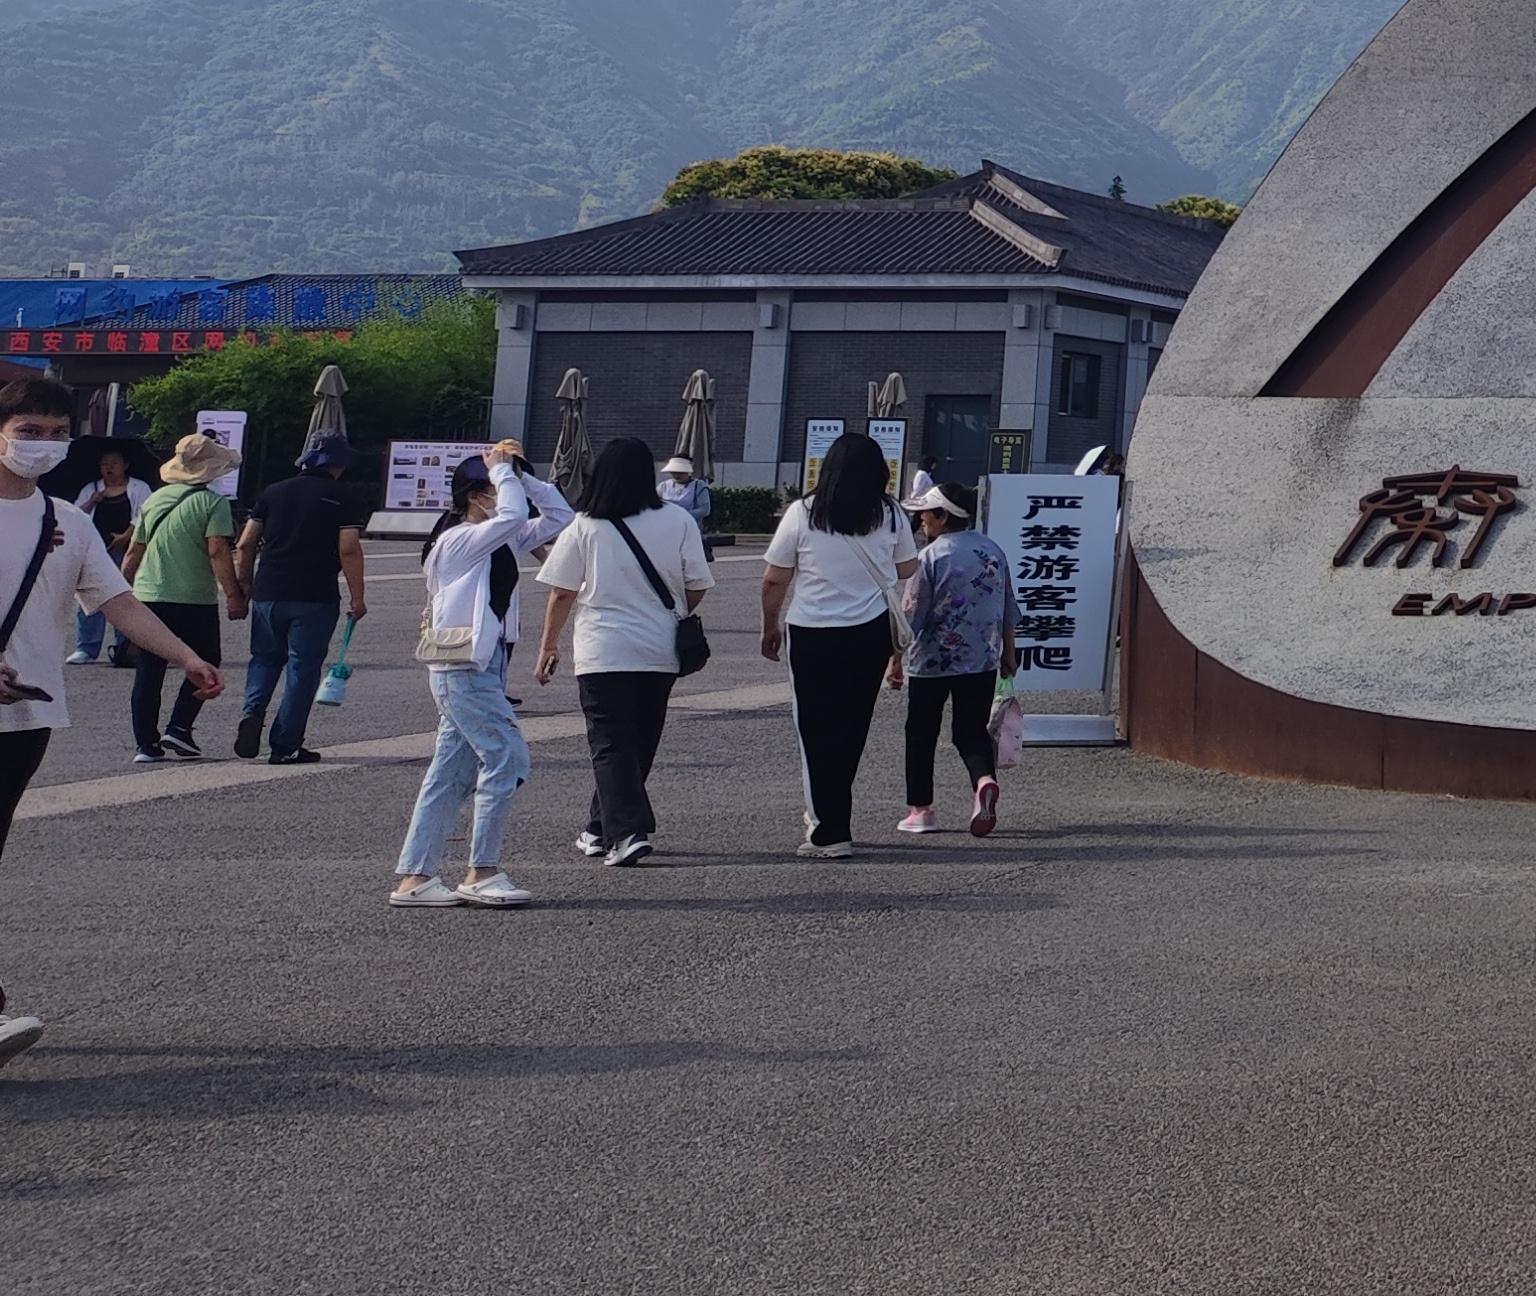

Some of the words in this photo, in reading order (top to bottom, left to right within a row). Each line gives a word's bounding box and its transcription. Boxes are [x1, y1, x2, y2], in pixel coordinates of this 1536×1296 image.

[1013, 495, 1084, 672] 严禁游客攀爬
